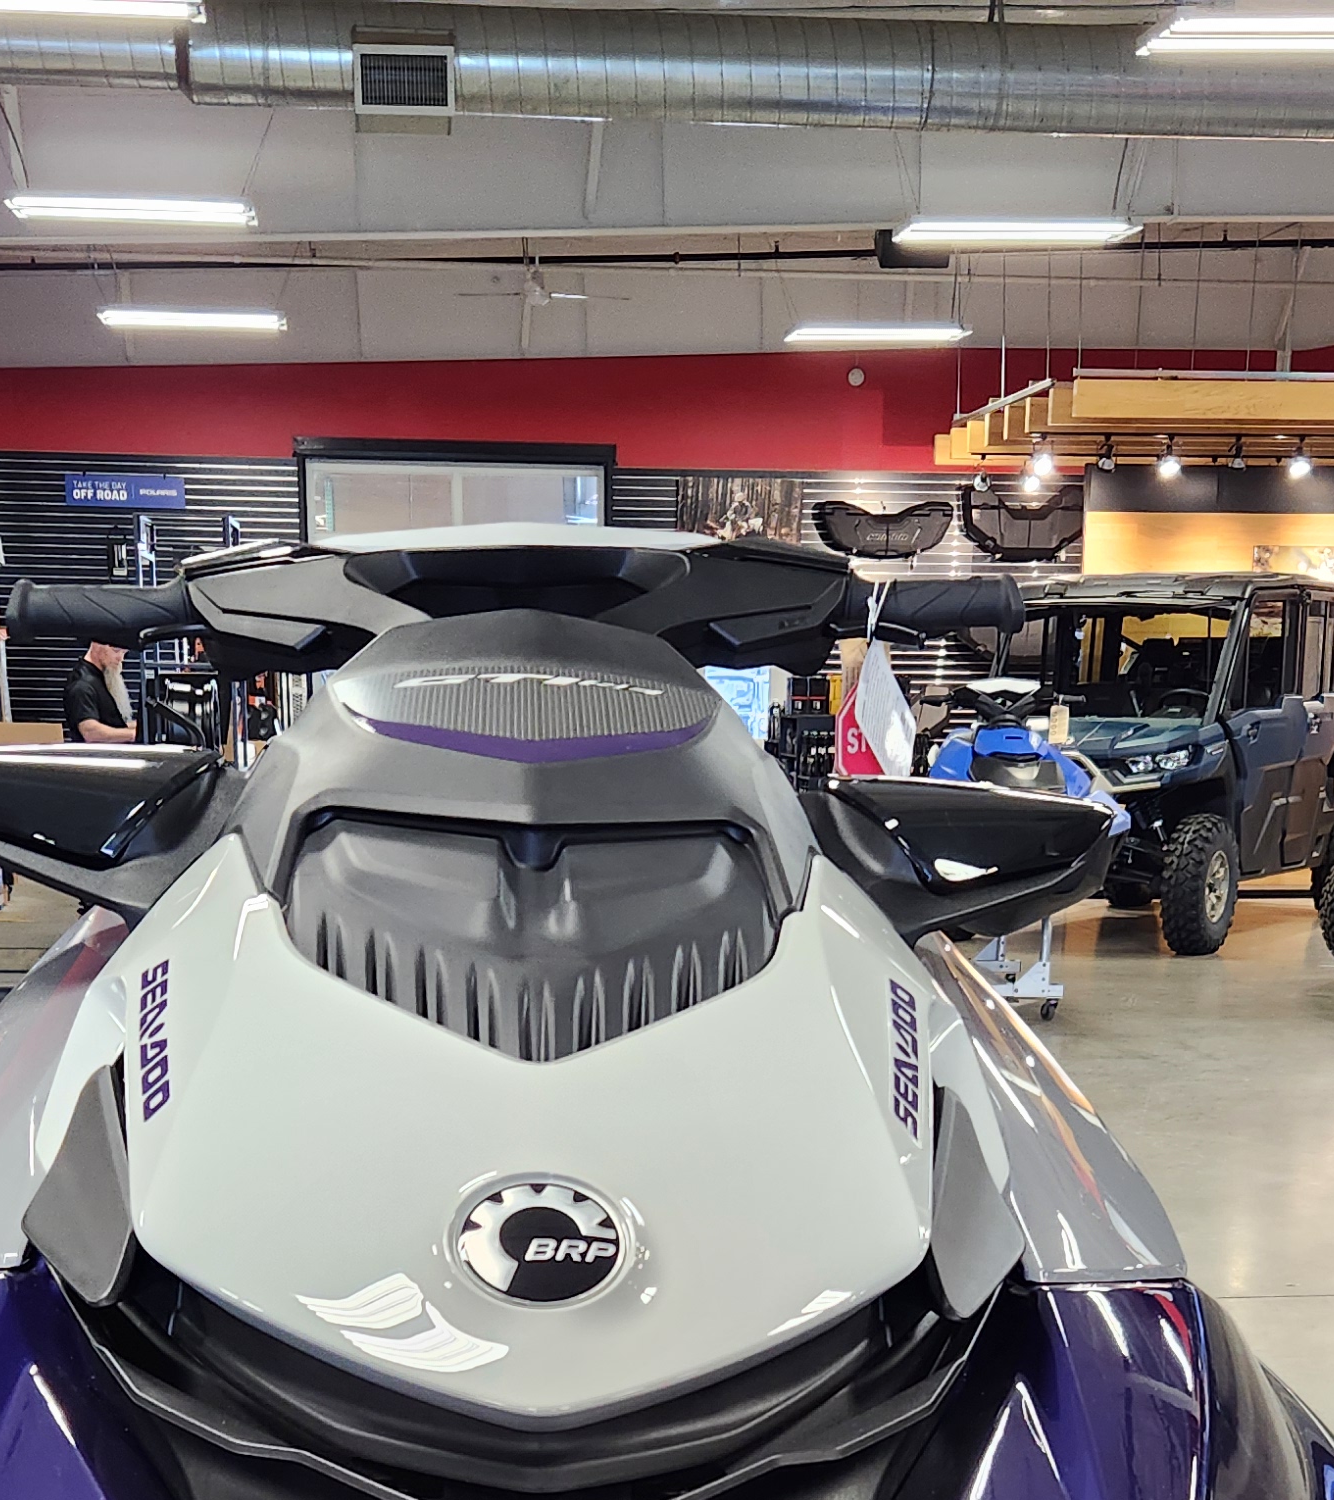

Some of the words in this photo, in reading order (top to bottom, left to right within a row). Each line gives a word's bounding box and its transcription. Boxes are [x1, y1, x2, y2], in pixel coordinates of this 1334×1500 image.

[73, 480, 92, 488] TAKE
[94, 481, 109, 489] THE
[111, 482, 127, 490] DAY
[72, 489, 94, 500] OFF
[96, 490, 128, 501] ROAD
[139, 488, 178, 497] POLARIS
[524, 1237, 617, 1263] BRP
